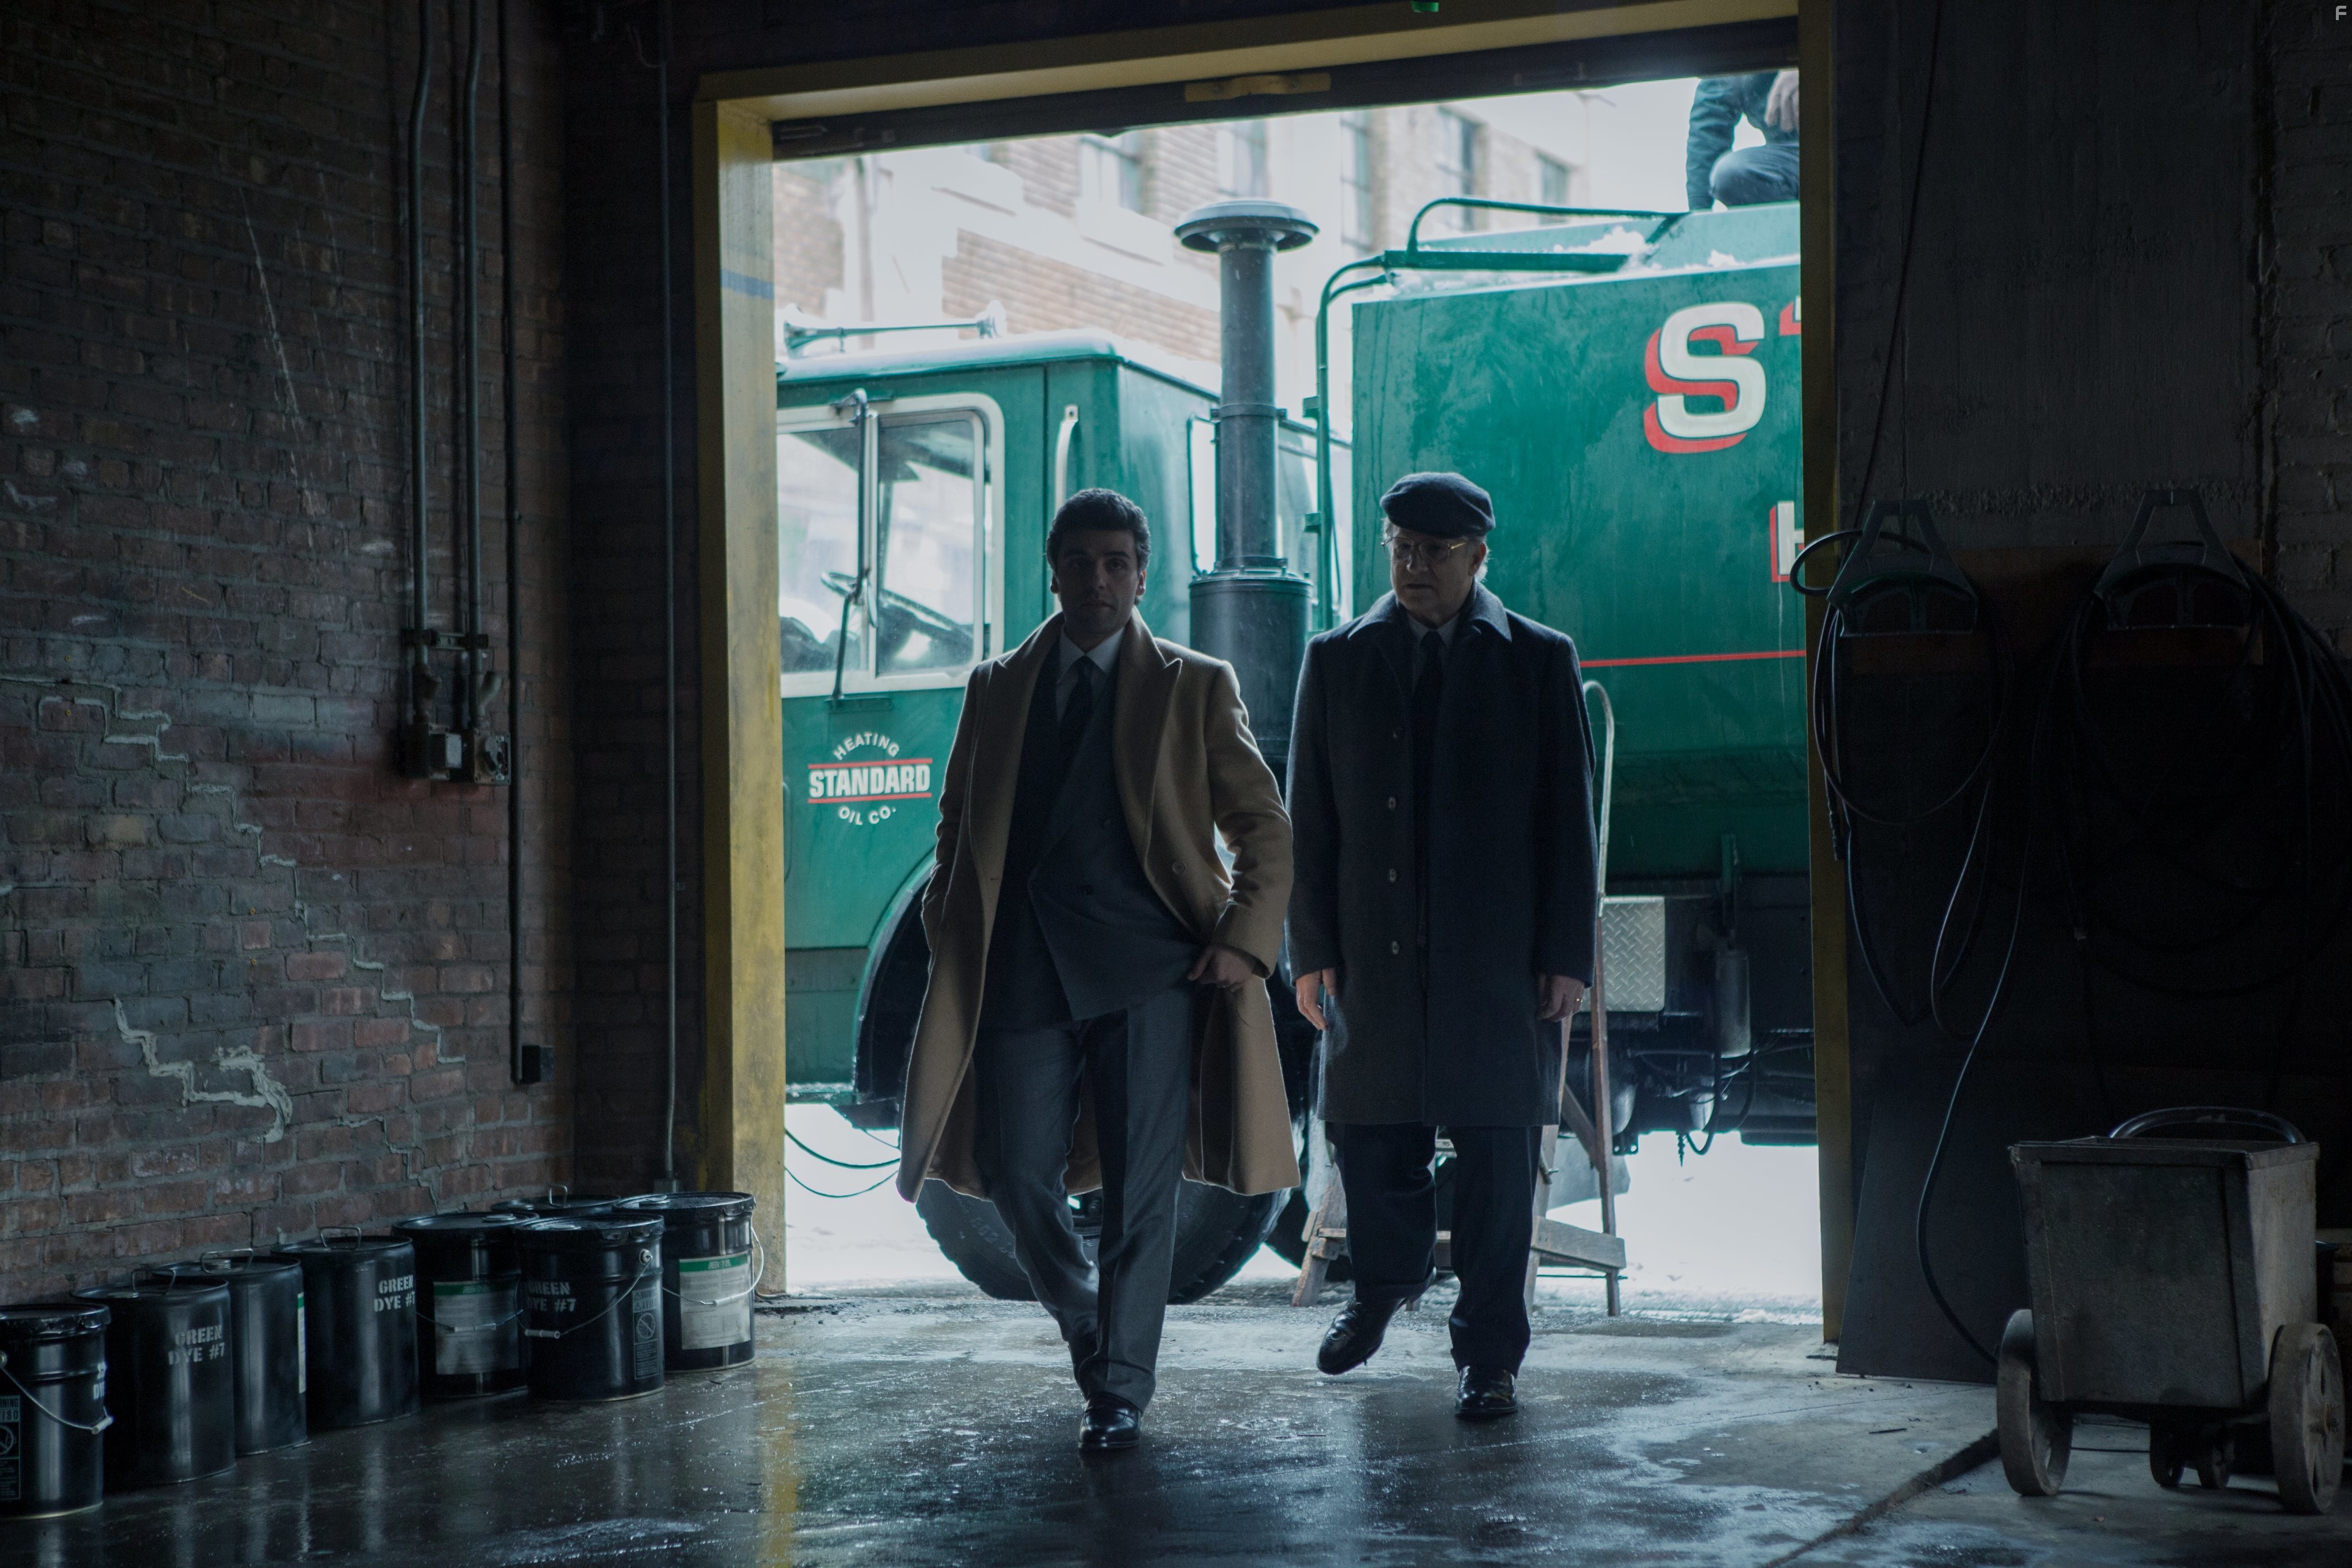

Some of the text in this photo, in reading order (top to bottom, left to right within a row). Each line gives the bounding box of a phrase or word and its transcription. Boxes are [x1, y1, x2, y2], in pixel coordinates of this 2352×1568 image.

[834, 732, 900, 760] HEATING
[809, 764, 930, 798] STANDARD
[838, 806, 864, 826] OIL
[379, 1274, 414, 1295] GREEN
[528, 1280, 570, 1295] GREEN
[374, 1295, 401, 1312] DYE
[554, 1298, 577, 1312] #7
[175, 1325, 222, 1345] GREEN
[168, 1342, 225, 1365] DYE #7
